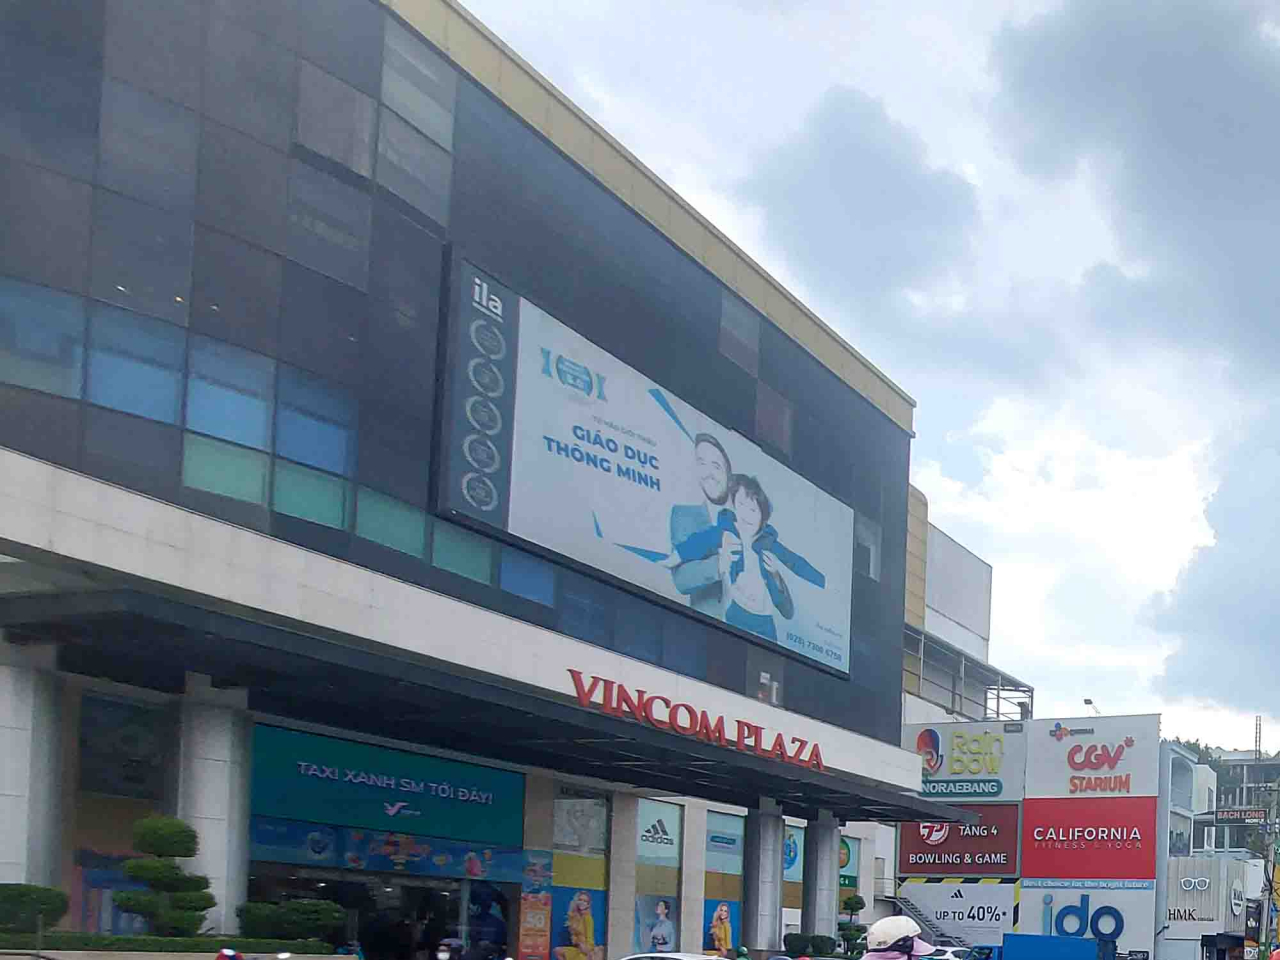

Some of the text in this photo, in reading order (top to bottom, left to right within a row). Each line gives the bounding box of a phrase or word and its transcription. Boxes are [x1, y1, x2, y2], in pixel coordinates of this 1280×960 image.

[572, 425, 660, 470] GIÁO DỤC
[543, 435, 661, 492] THÔNG MINH
[567, 669, 825, 771] VINCOM PLAZA
[951, 730, 1004, 756] Rain
[1067, 743, 1126, 771] CGV
[297, 761, 493, 805] TAXI XANH SM TỚI ĐÂY!
[921, 782, 998, 793] NORAEBANG
[1069, 773, 1131, 793] STARIUM
[1241, 811, 1265, 819] LONG
[991, 825, 998, 836] 4
[1033, 827, 1142, 840] CALIFORNIA
[640, 834, 674, 845] adidas
[1034, 841, 1086, 849] FITNESS
[1107, 841, 1142, 849] YOGA
[909, 853, 1007, 864] BOWLING & GAME
[935, 911, 949, 921] UP
[951, 911, 964, 921] TO
[1043, 893, 1124, 941] ido
[1168, 908, 1197, 921] HMK
